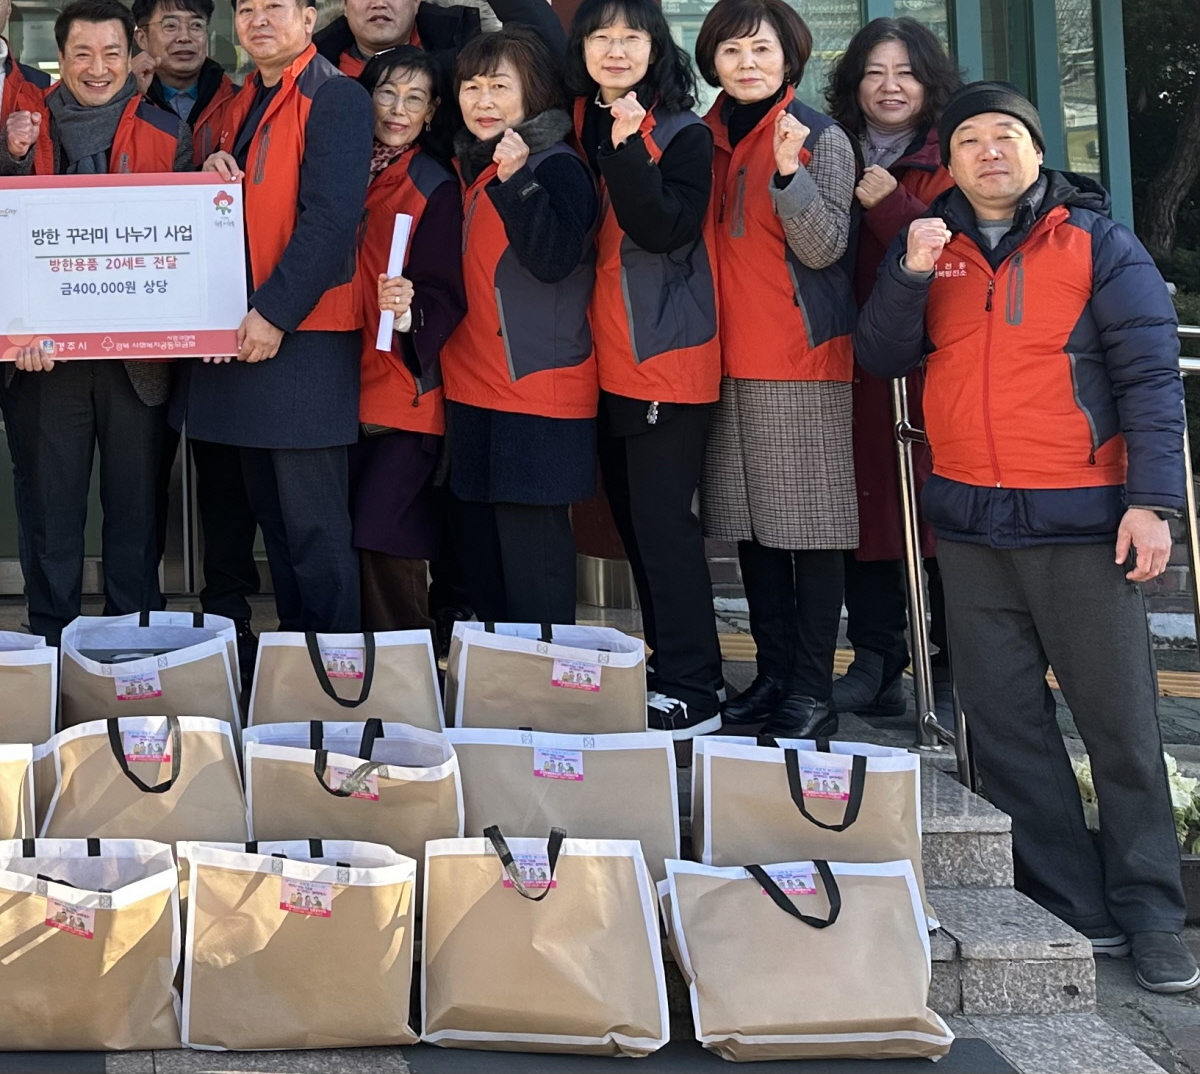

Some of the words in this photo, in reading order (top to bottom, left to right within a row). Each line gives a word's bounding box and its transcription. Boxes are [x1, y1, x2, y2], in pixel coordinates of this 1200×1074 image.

[31, 228, 60, 246] 방한
[65, 227, 108, 245] 꾸러미
[115, 226, 158, 243] 나누기
[164, 224, 194, 242] 사업
[48, 258, 100, 273] 방한용품
[105, 256, 147, 271] 20세트
[152, 255, 179, 270] 전달
[59, 281, 137, 296] 금400,000원
[143, 279, 169, 295] 상당
[56, 341, 88, 352] 경주시
